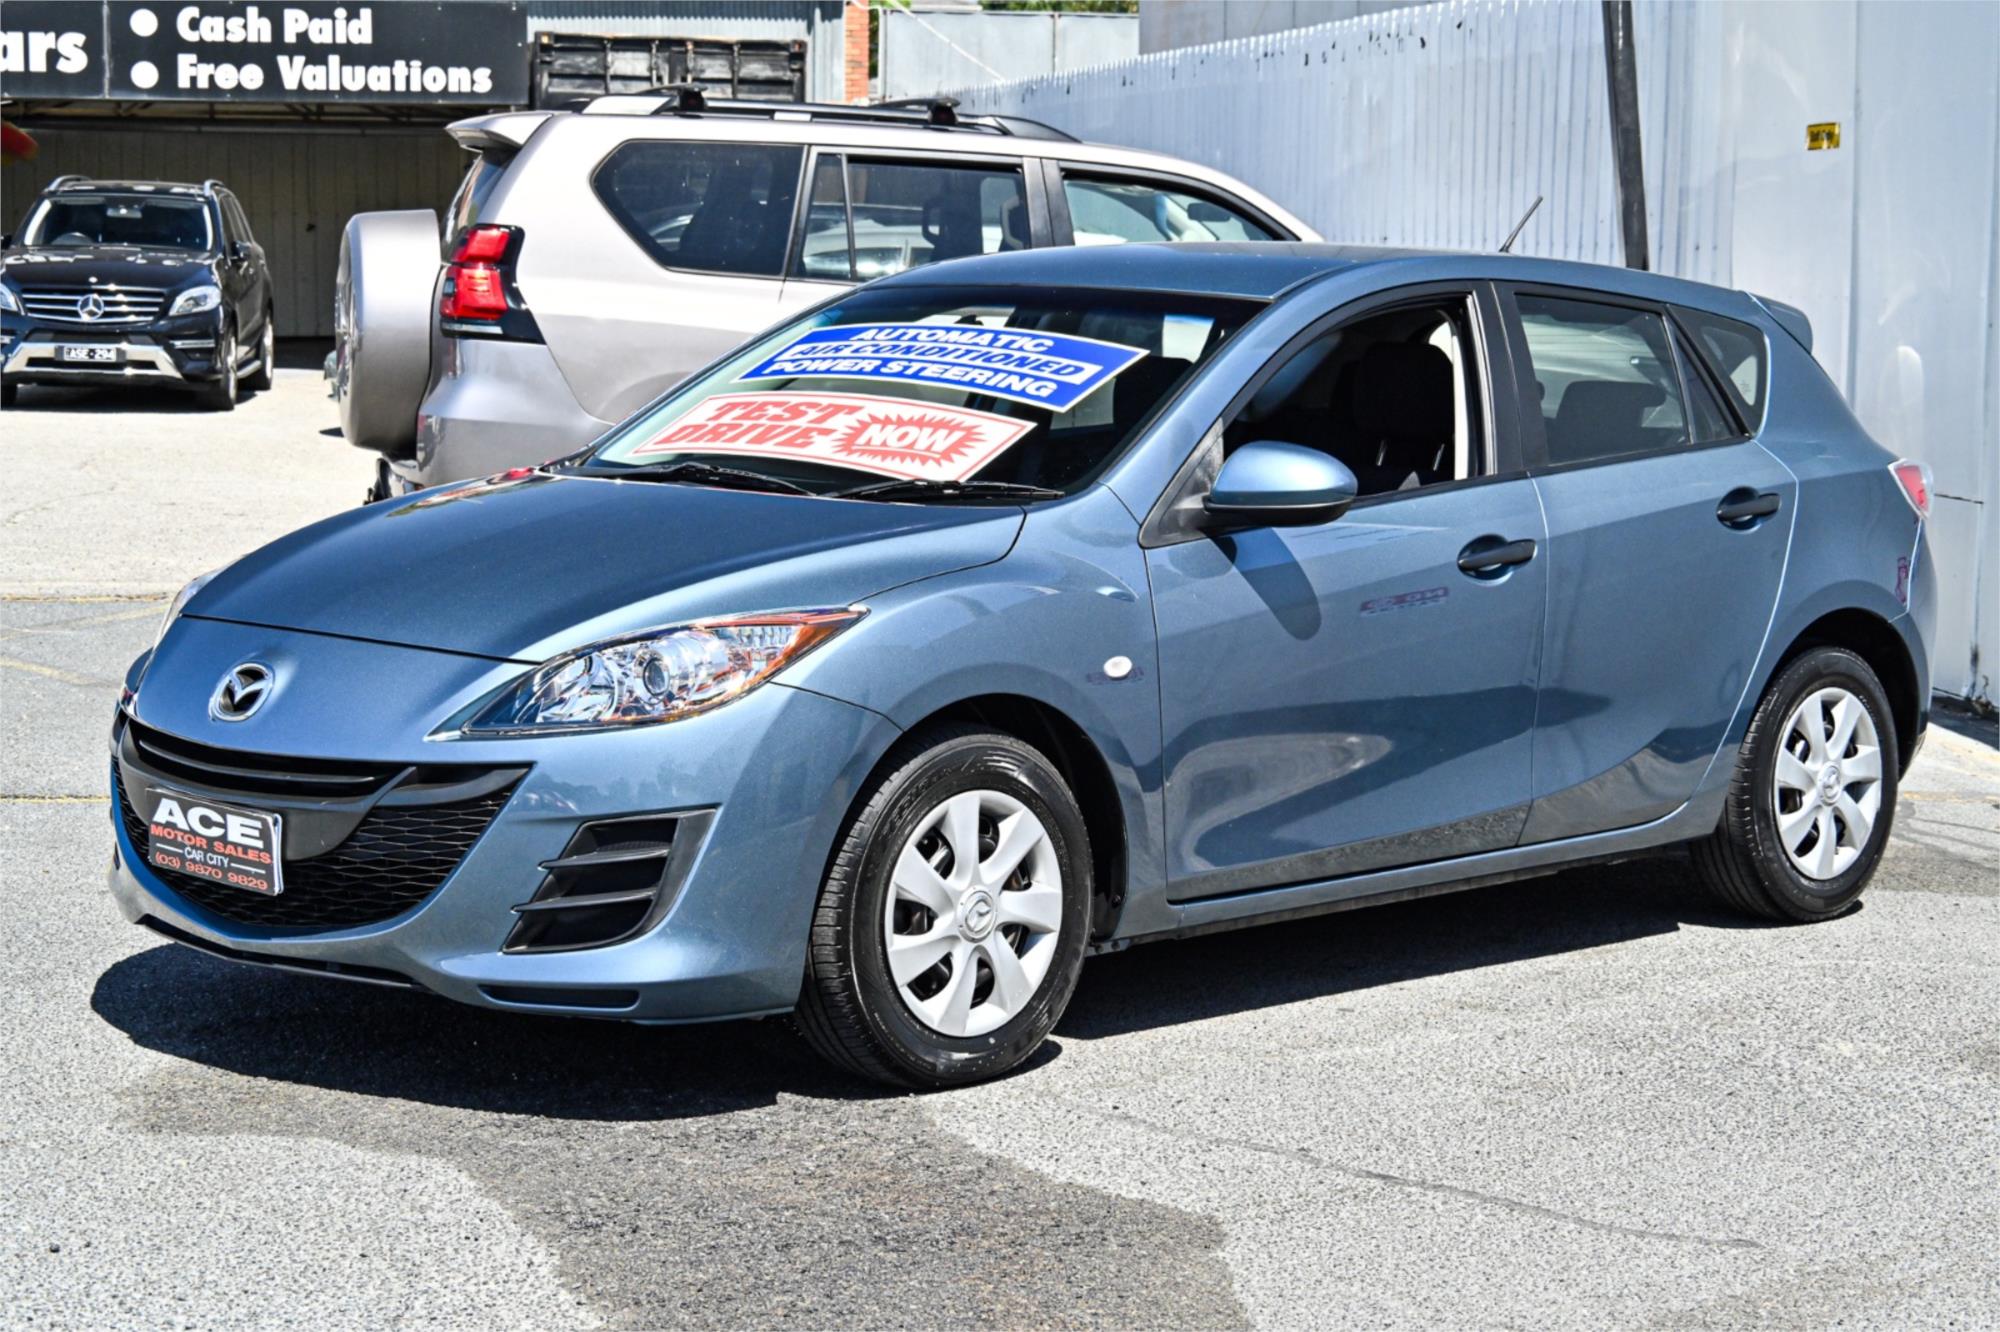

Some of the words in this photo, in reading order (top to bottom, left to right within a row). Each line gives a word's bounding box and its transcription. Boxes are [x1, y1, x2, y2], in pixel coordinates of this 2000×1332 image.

[176, 6, 272, 43] Cash
[283, 7, 373, 44] Paid
[177, 53, 264, 90] Free
[276, 54, 493, 93] Valuations
[849, 328, 1055, 352] AUTOMATIC
[853, 343, 1086, 377] CONDITIONED
[761, 359, 877, 374] POWER
[880, 361, 1058, 398] STEERING
[706, 402, 864, 425] TEST
[653, 423, 838, 448] DRIVE
[856, 424, 966, 452] NOW
[152, 798, 264, 849] ACE
[150, 823, 208, 849] MOTOR
[213, 841, 272, 865] SALES
[184, 846, 204, 862] CAR
[206, 853, 229, 868] CITY
[155, 851, 180, 869] (03)
[185, 861, 222, 879] 9870
[227, 872, 268, 891] 9829
